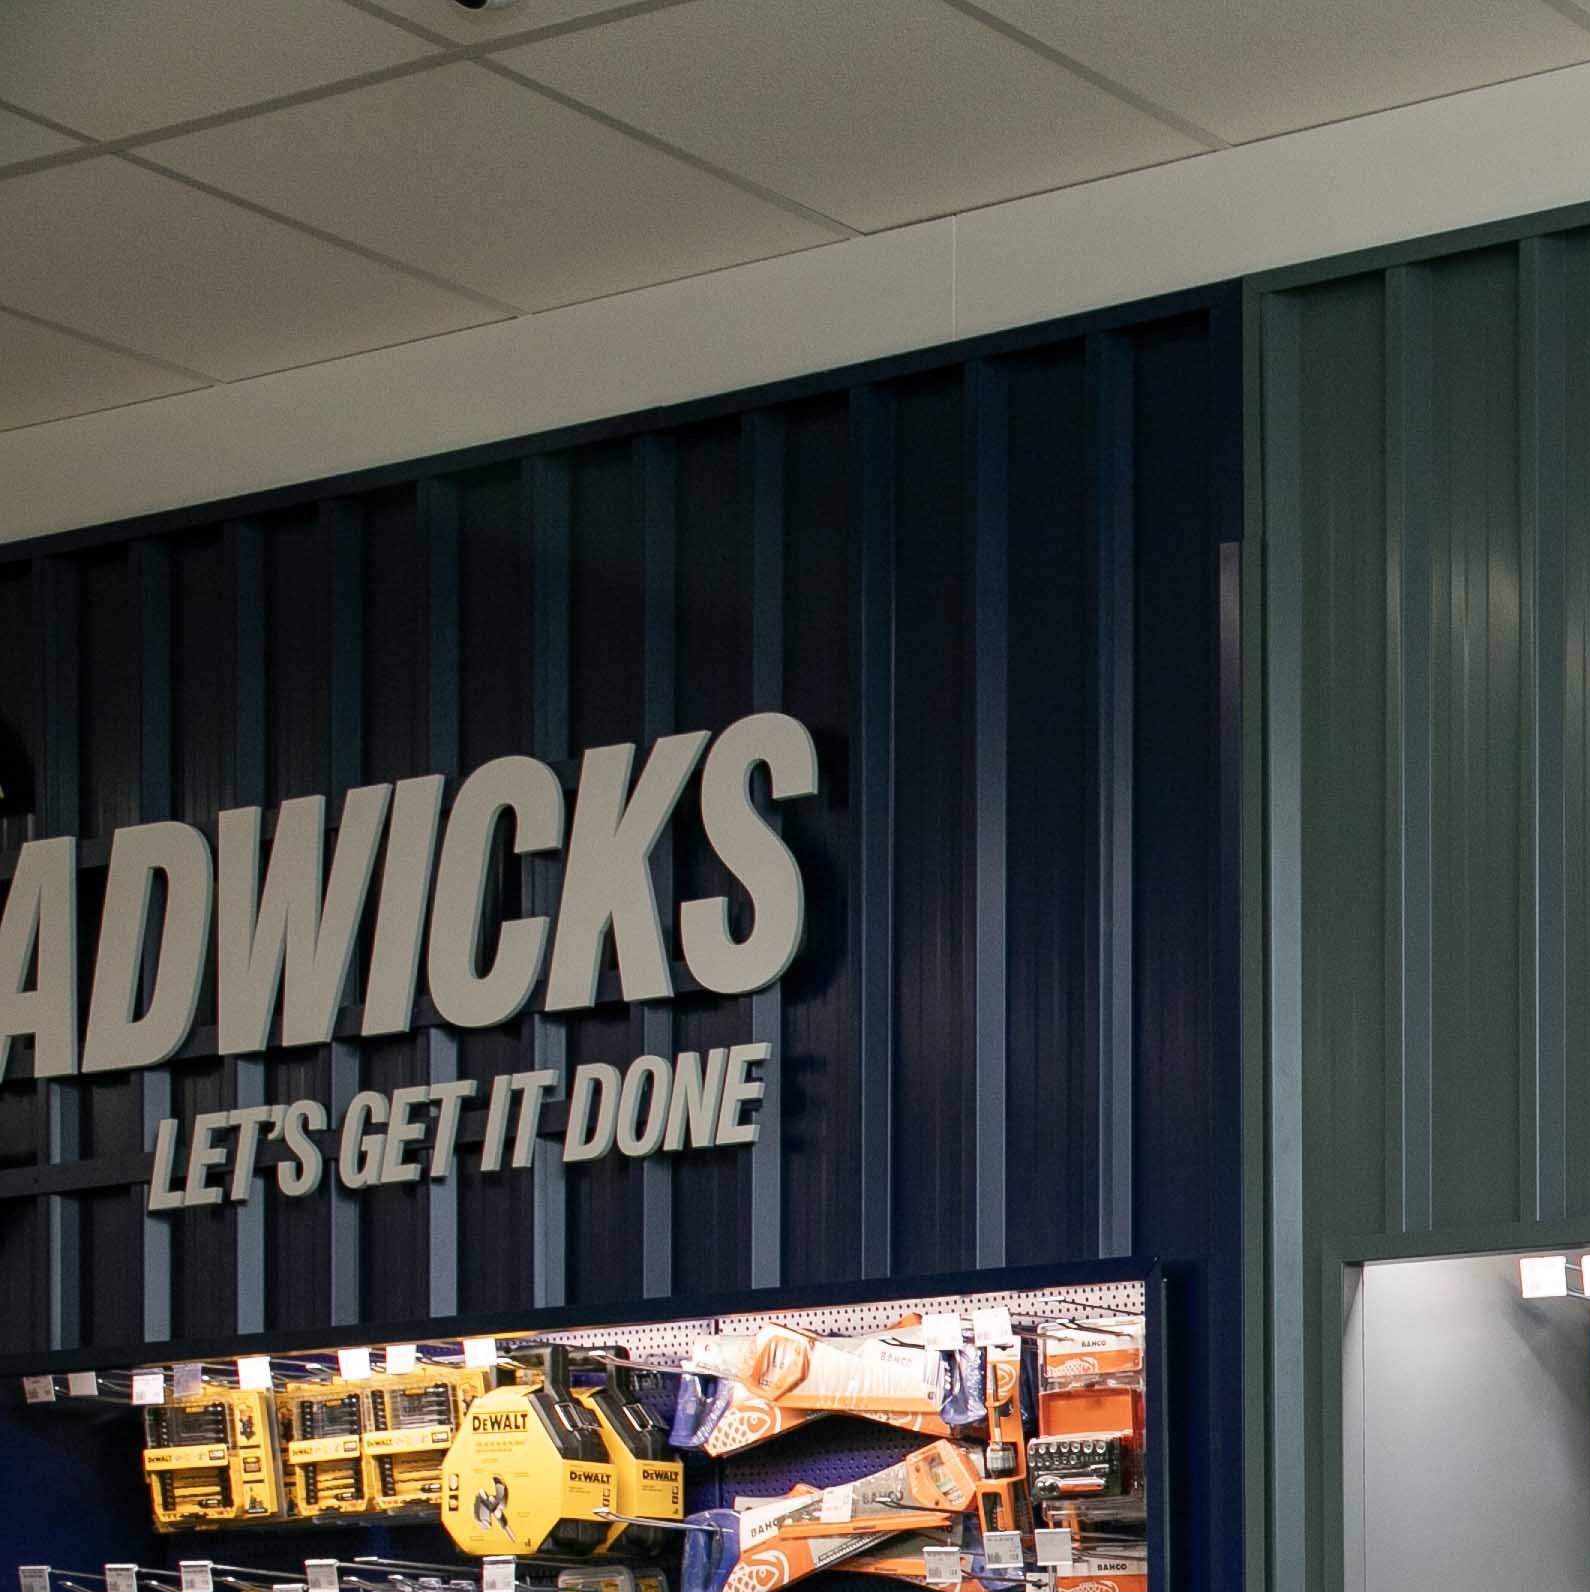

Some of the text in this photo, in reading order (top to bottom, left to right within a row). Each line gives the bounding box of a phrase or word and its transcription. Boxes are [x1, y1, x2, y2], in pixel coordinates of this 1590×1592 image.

[0, 712, 819, 1079] ADWICKS
[147, 1043, 772, 1211] LET'S GET IT DONE
[1097, 1562, 1128, 1572] BAHCO
